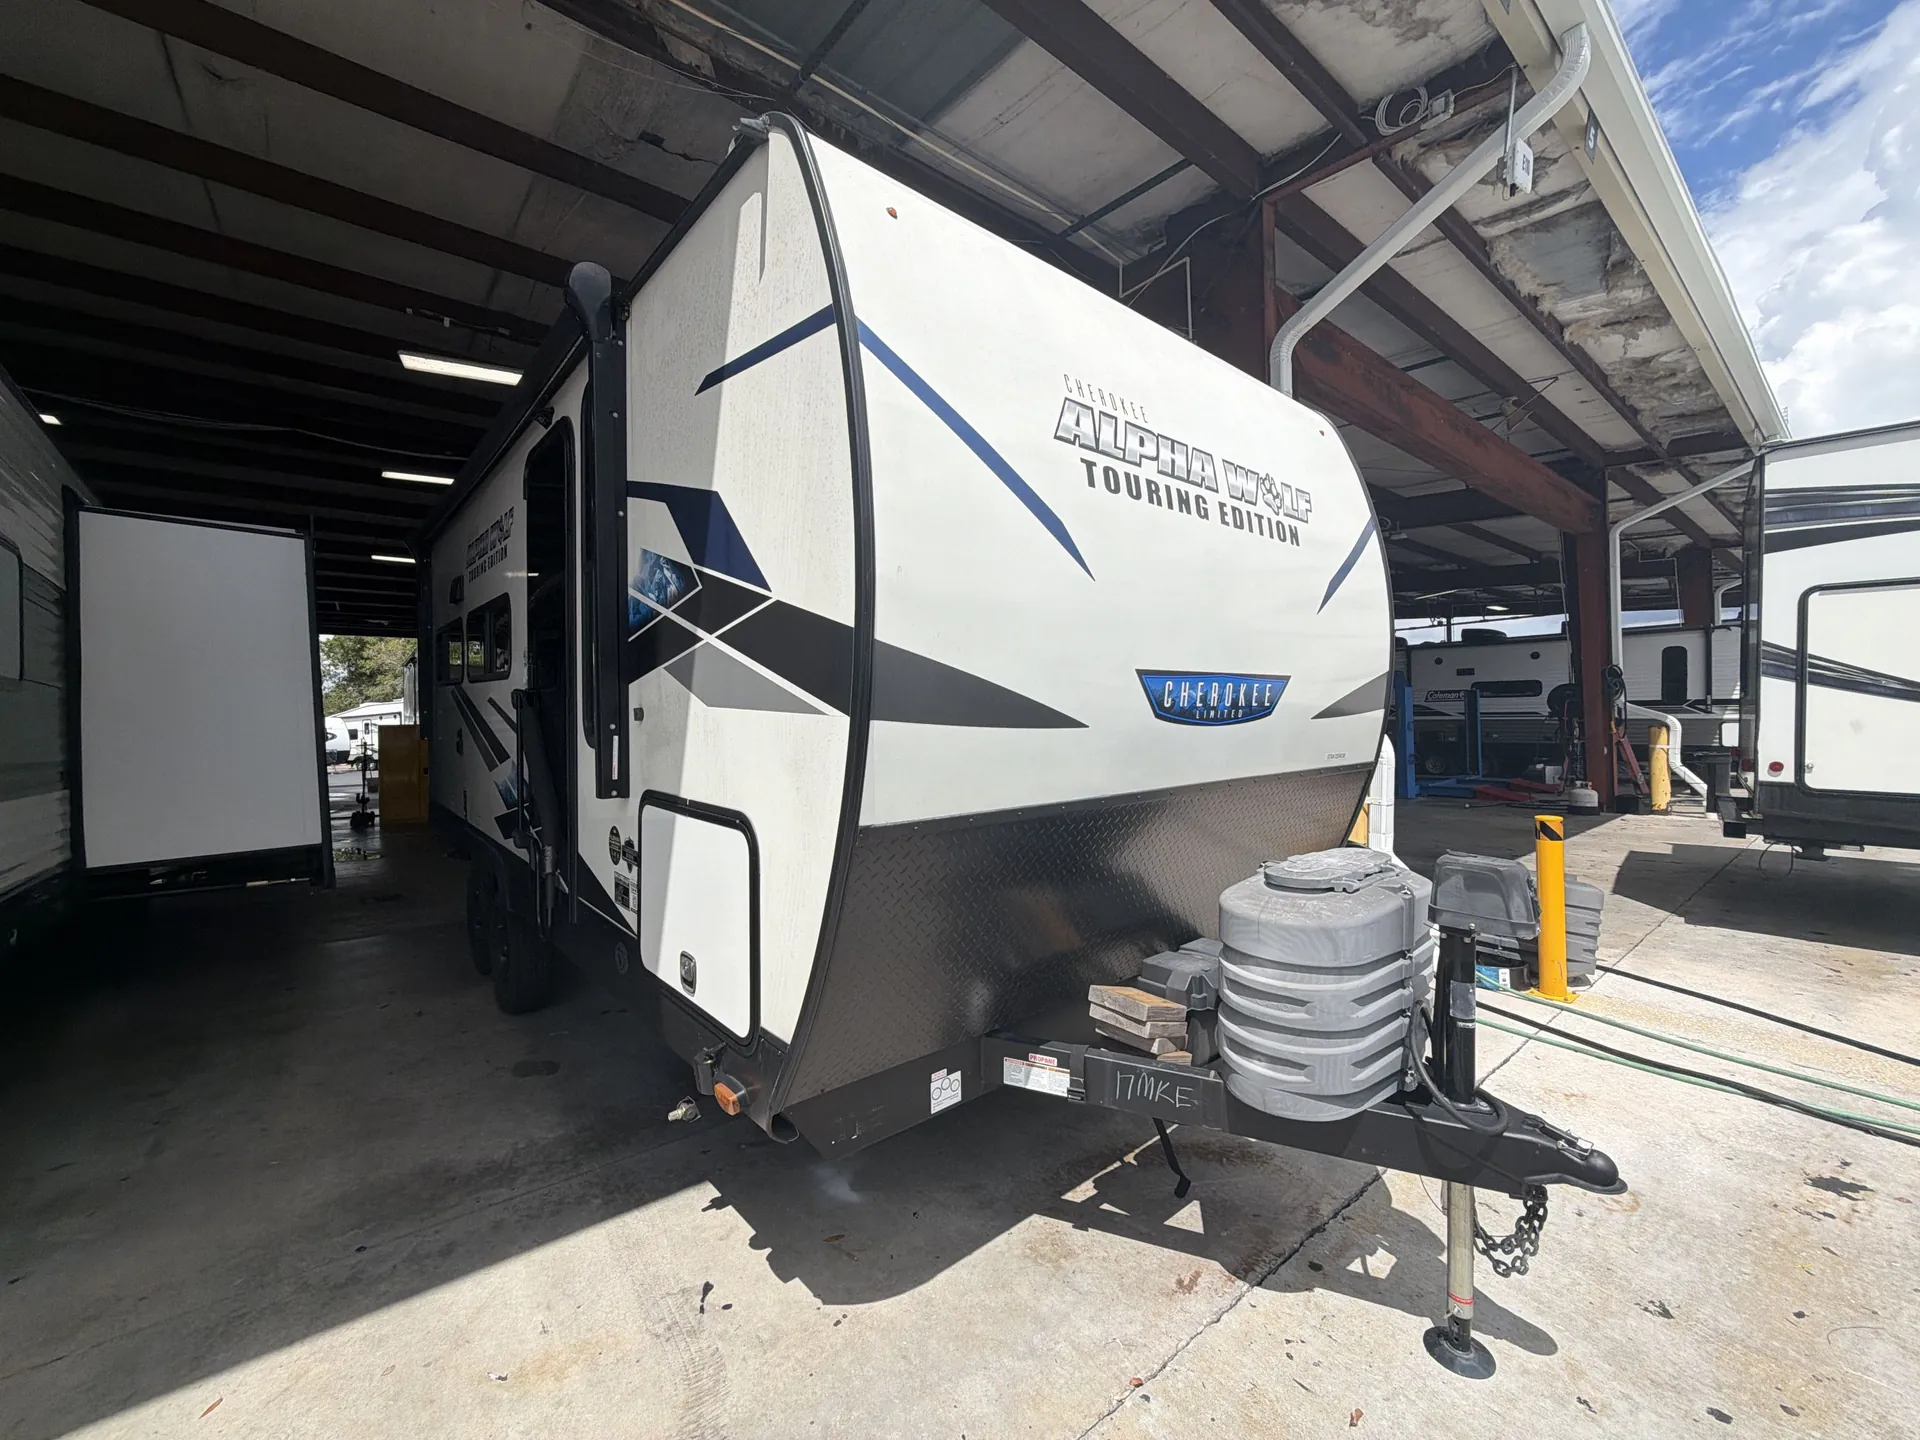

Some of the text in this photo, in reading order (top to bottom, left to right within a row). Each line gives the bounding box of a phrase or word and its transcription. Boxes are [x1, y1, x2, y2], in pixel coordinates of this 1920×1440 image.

[1588, 126, 1595, 149] 5
[1063, 374, 1149, 424] CHEROKEE
[1054, 397, 1219, 493] ALPHA
[1080, 457, 1300, 547] TOURING EDITION
[1163, 680, 1272, 708] CHEROKEE
[1428, 691, 1459, 700] Coleman
[1196, 709, 1243, 719] LIMITED
[1030, 1054, 1056, 1066] PROPANE
